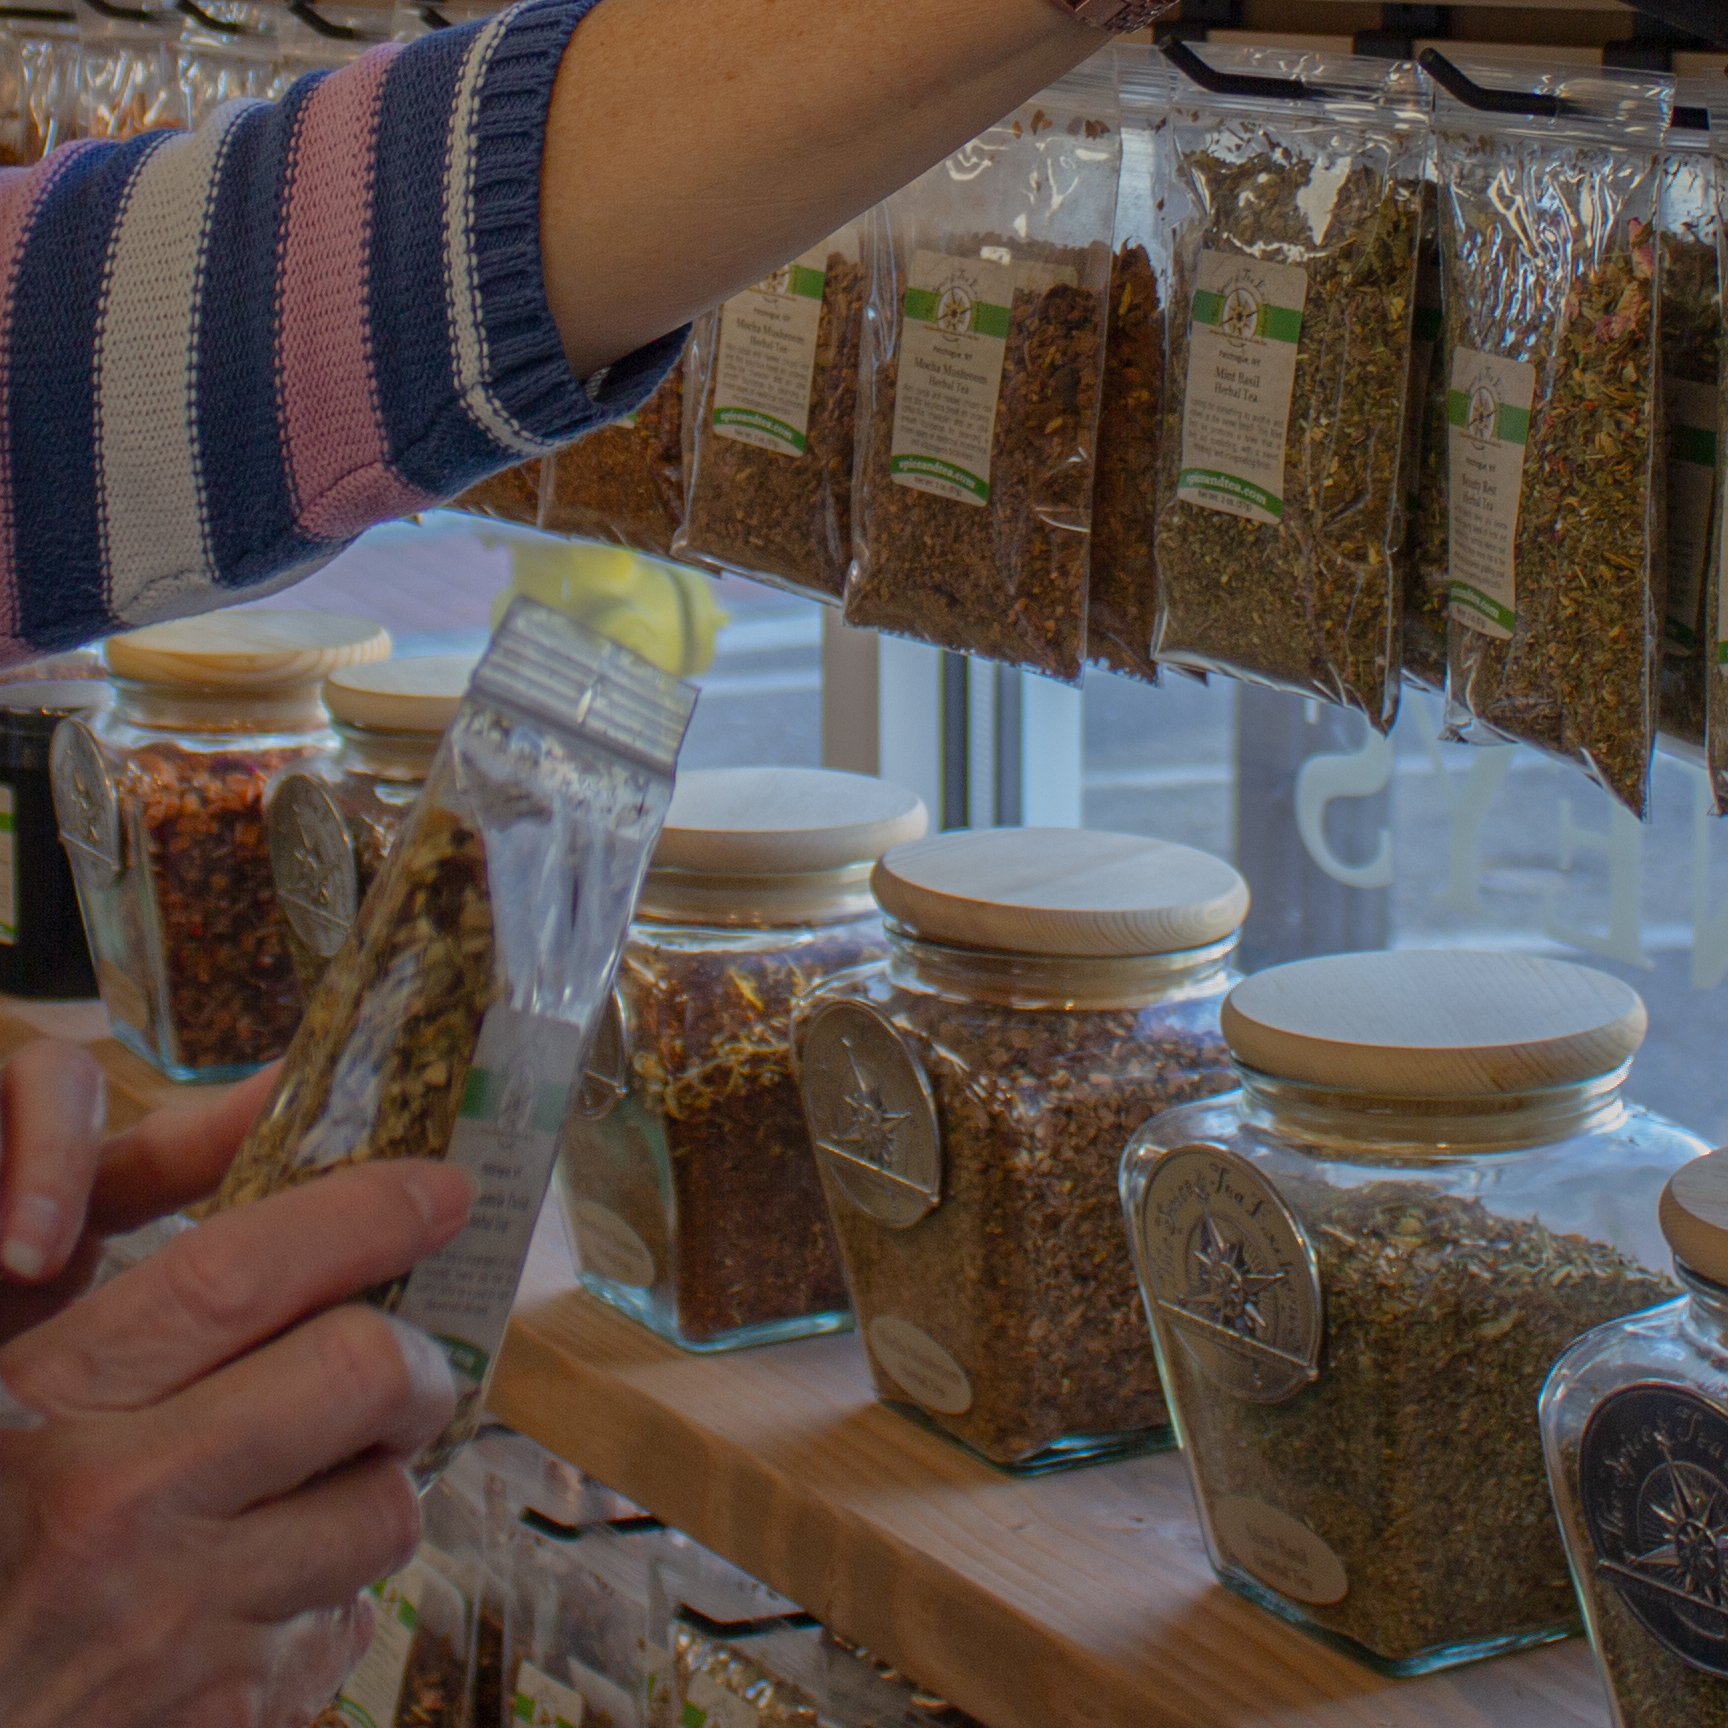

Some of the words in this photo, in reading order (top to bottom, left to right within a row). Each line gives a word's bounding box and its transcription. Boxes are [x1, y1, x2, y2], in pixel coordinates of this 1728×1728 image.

[915, 357, 942, 375] Mocha
[943, 364, 987, 384] Mushroom
[1215, 365, 1236, 383] Mint
[1238, 370, 1261, 389] Basil
[929, 375, 954, 391] Herbal
[956, 383, 970, 395] Tea
[1214, 381, 1241, 400] Herbal
[1243, 388, 1259, 403] Tea
[899, 459, 975, 489] spiceandtea.com
[1674, 1405, 1723, 1458] Tea
